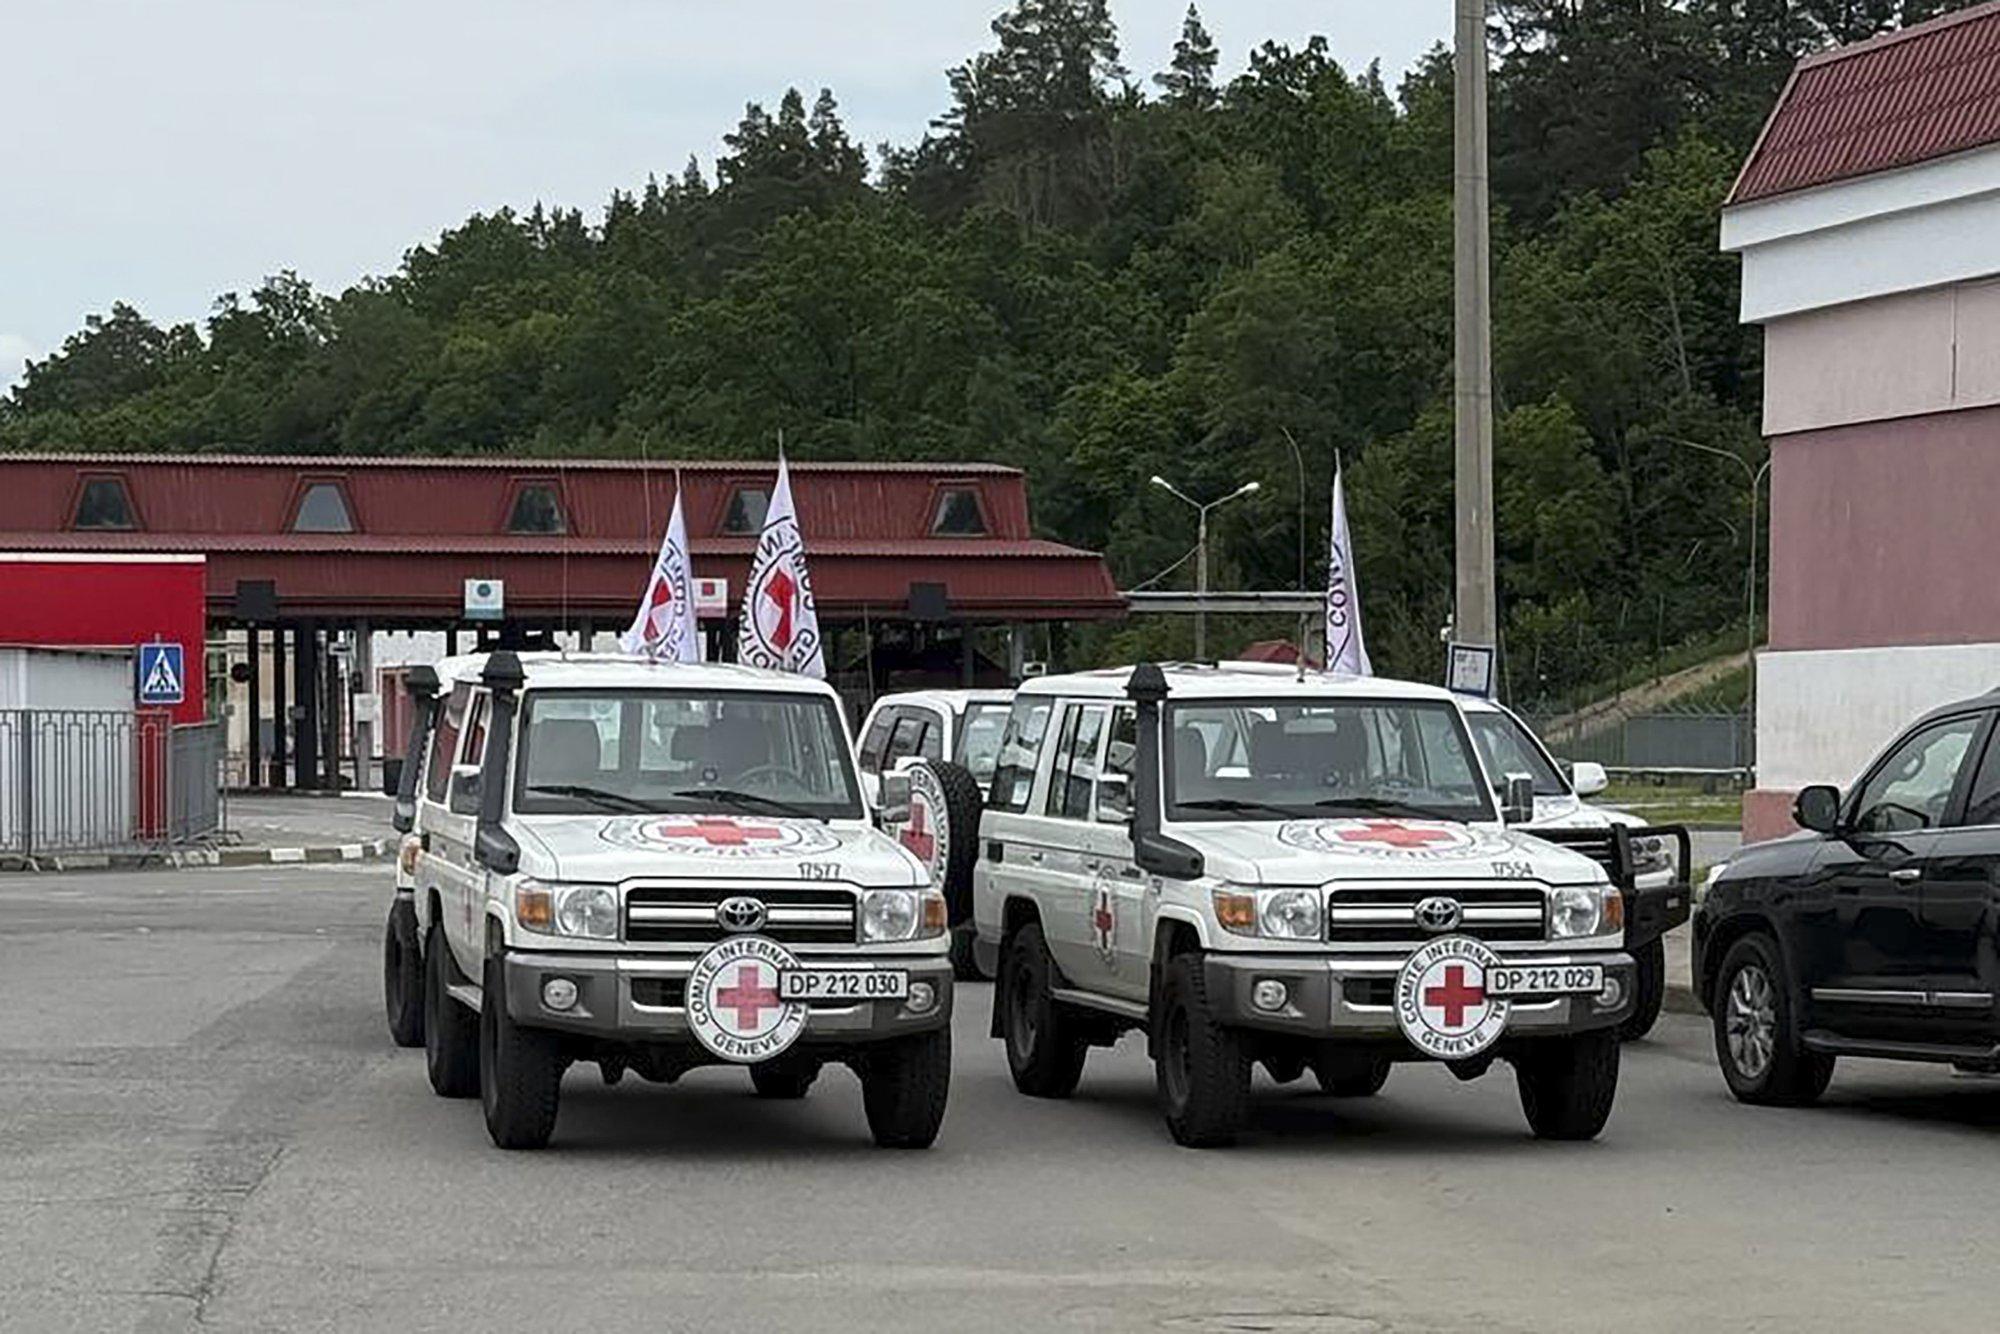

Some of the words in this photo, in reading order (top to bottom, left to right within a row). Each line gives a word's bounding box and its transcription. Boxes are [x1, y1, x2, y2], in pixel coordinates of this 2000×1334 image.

[798, 862, 841, 879] 17577
[789, 974, 819, 994] DP
[827, 974, 859, 995] 212
[866, 973, 899, 995] 030
[1495, 971, 1523, 991] DP
[1527, 969, 1559, 990] 212
[1565, 967, 1594, 988] 029
[691, 958, 717, 1026] COMITE
[1401, 959, 1425, 1024] COMITE
[713, 1031, 784, 1055] GENEVE
[1421, 1030, 1487, 1052] GENEVE
